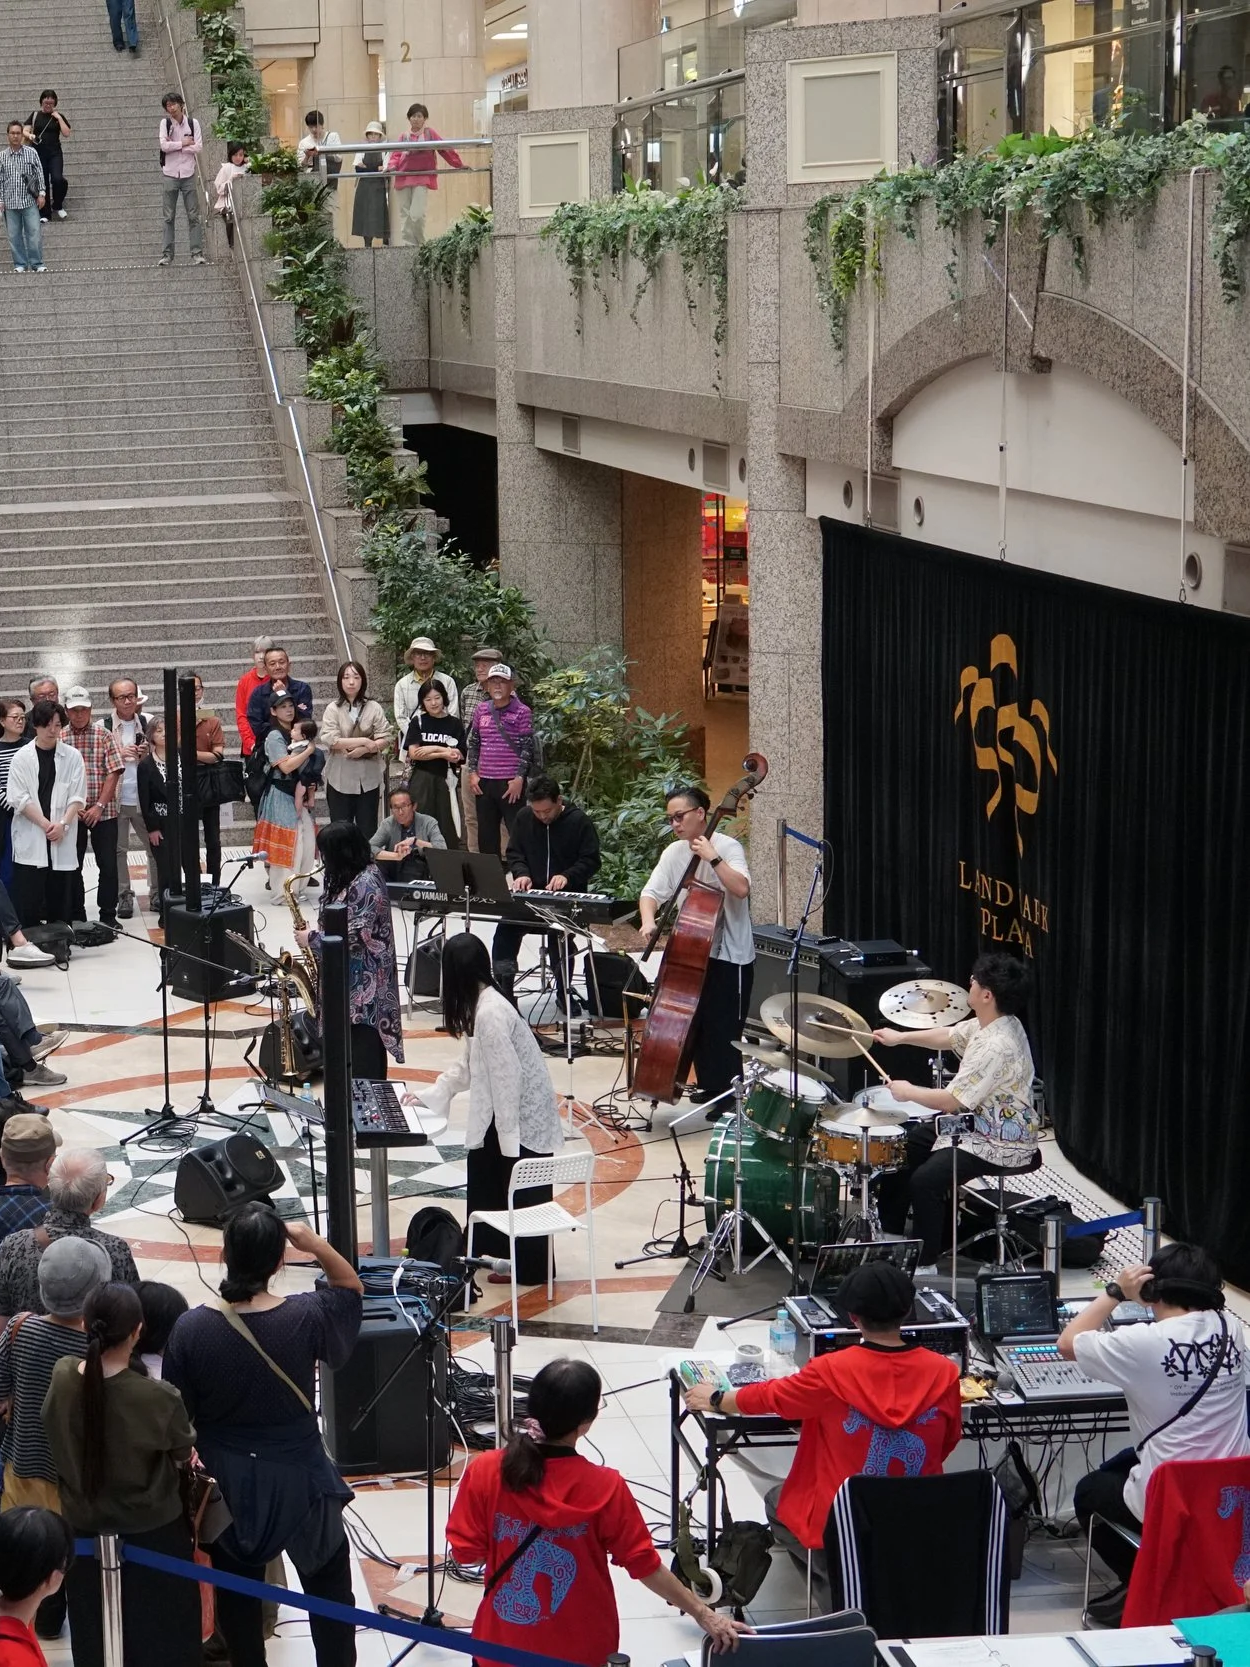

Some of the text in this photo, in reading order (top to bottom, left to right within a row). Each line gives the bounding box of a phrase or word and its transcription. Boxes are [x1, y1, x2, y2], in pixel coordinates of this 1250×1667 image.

[400, 41, 412, 63] 2
[421, 891, 448, 902] YAMAHA
[959, 860, 1049, 934] LANDARK
[980, 907, 1034, 959] PLAA
